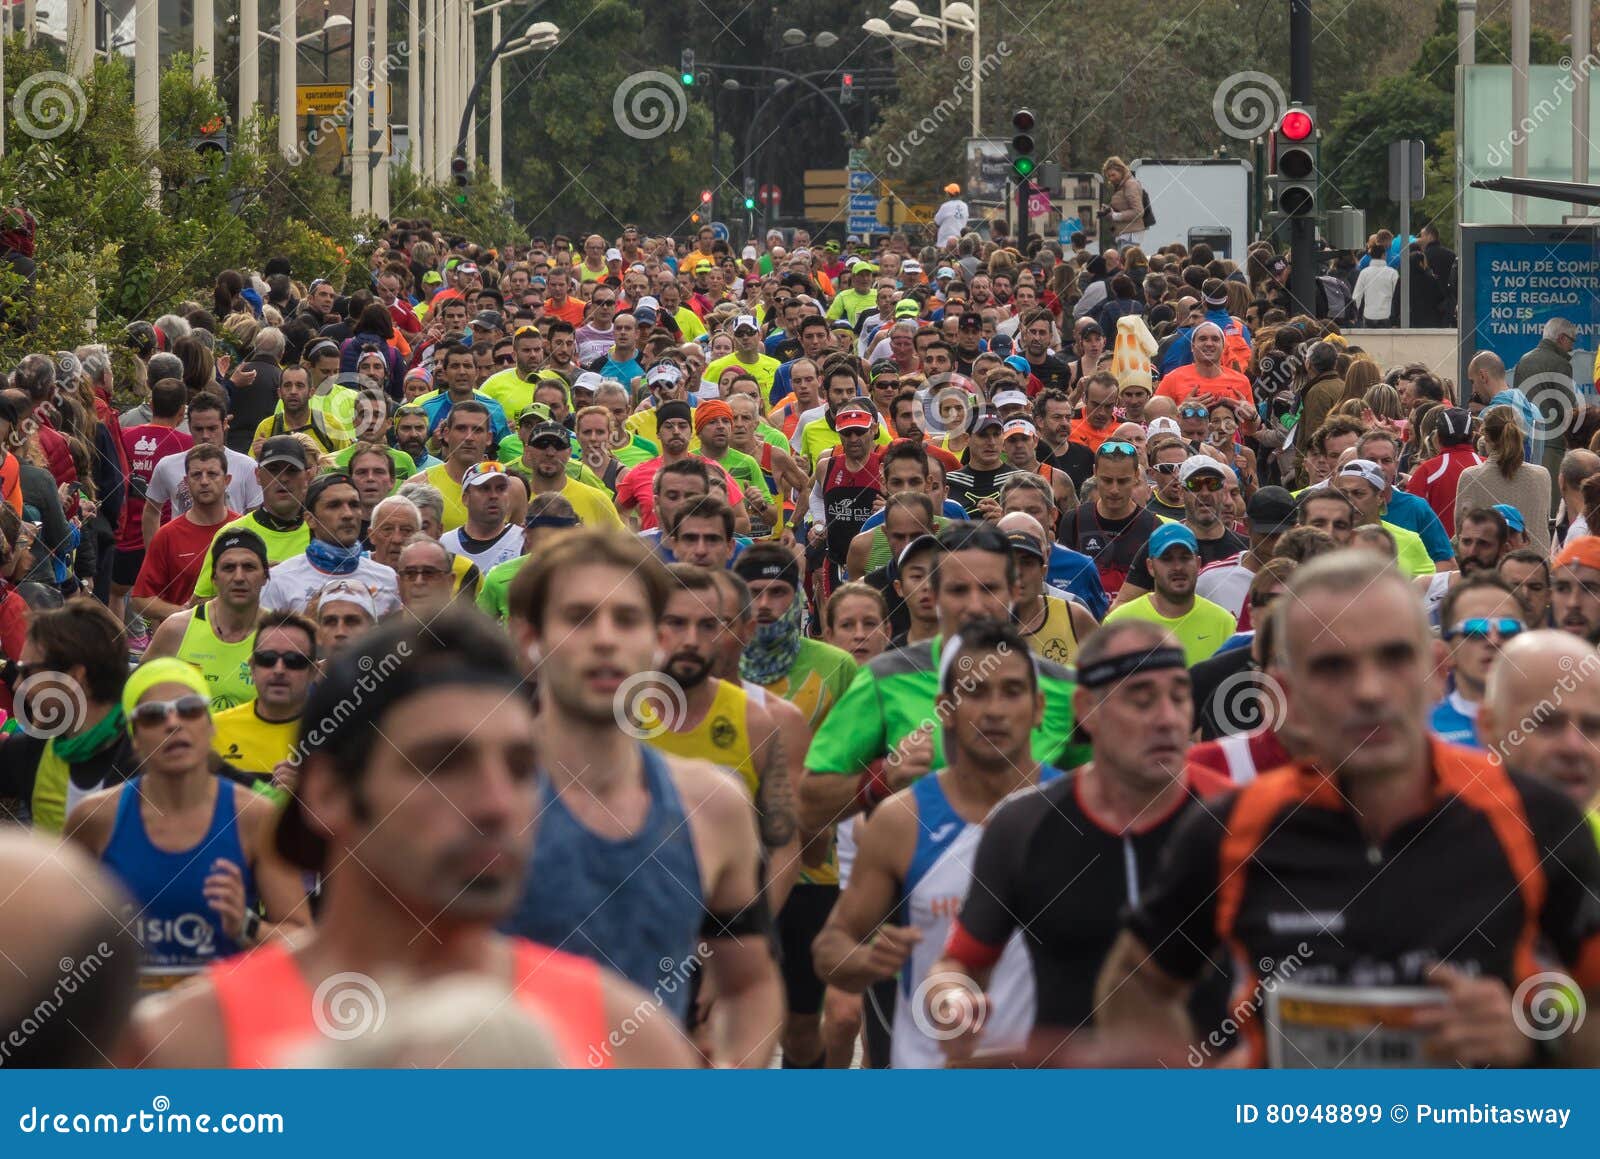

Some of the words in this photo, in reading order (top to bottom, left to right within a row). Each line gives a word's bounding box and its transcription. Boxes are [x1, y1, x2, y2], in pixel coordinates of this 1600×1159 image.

[1491, 260, 1531, 272] SALIR
[1534, 261, 1554, 272] DE
[1557, 261, 1600, 273] COMP
[1491, 275, 1502, 287] Y
[1504, 276, 1526, 288] NO
[1529, 276, 1600, 288] ENCONTR
[1491, 291, 1518, 303] ESE
[1520, 292, 1581, 305] REGALO,
[1491, 307, 1513, 318] NO
[1516, 307, 1534, 319] ES
[1491, 322, 1519, 334] TAN
